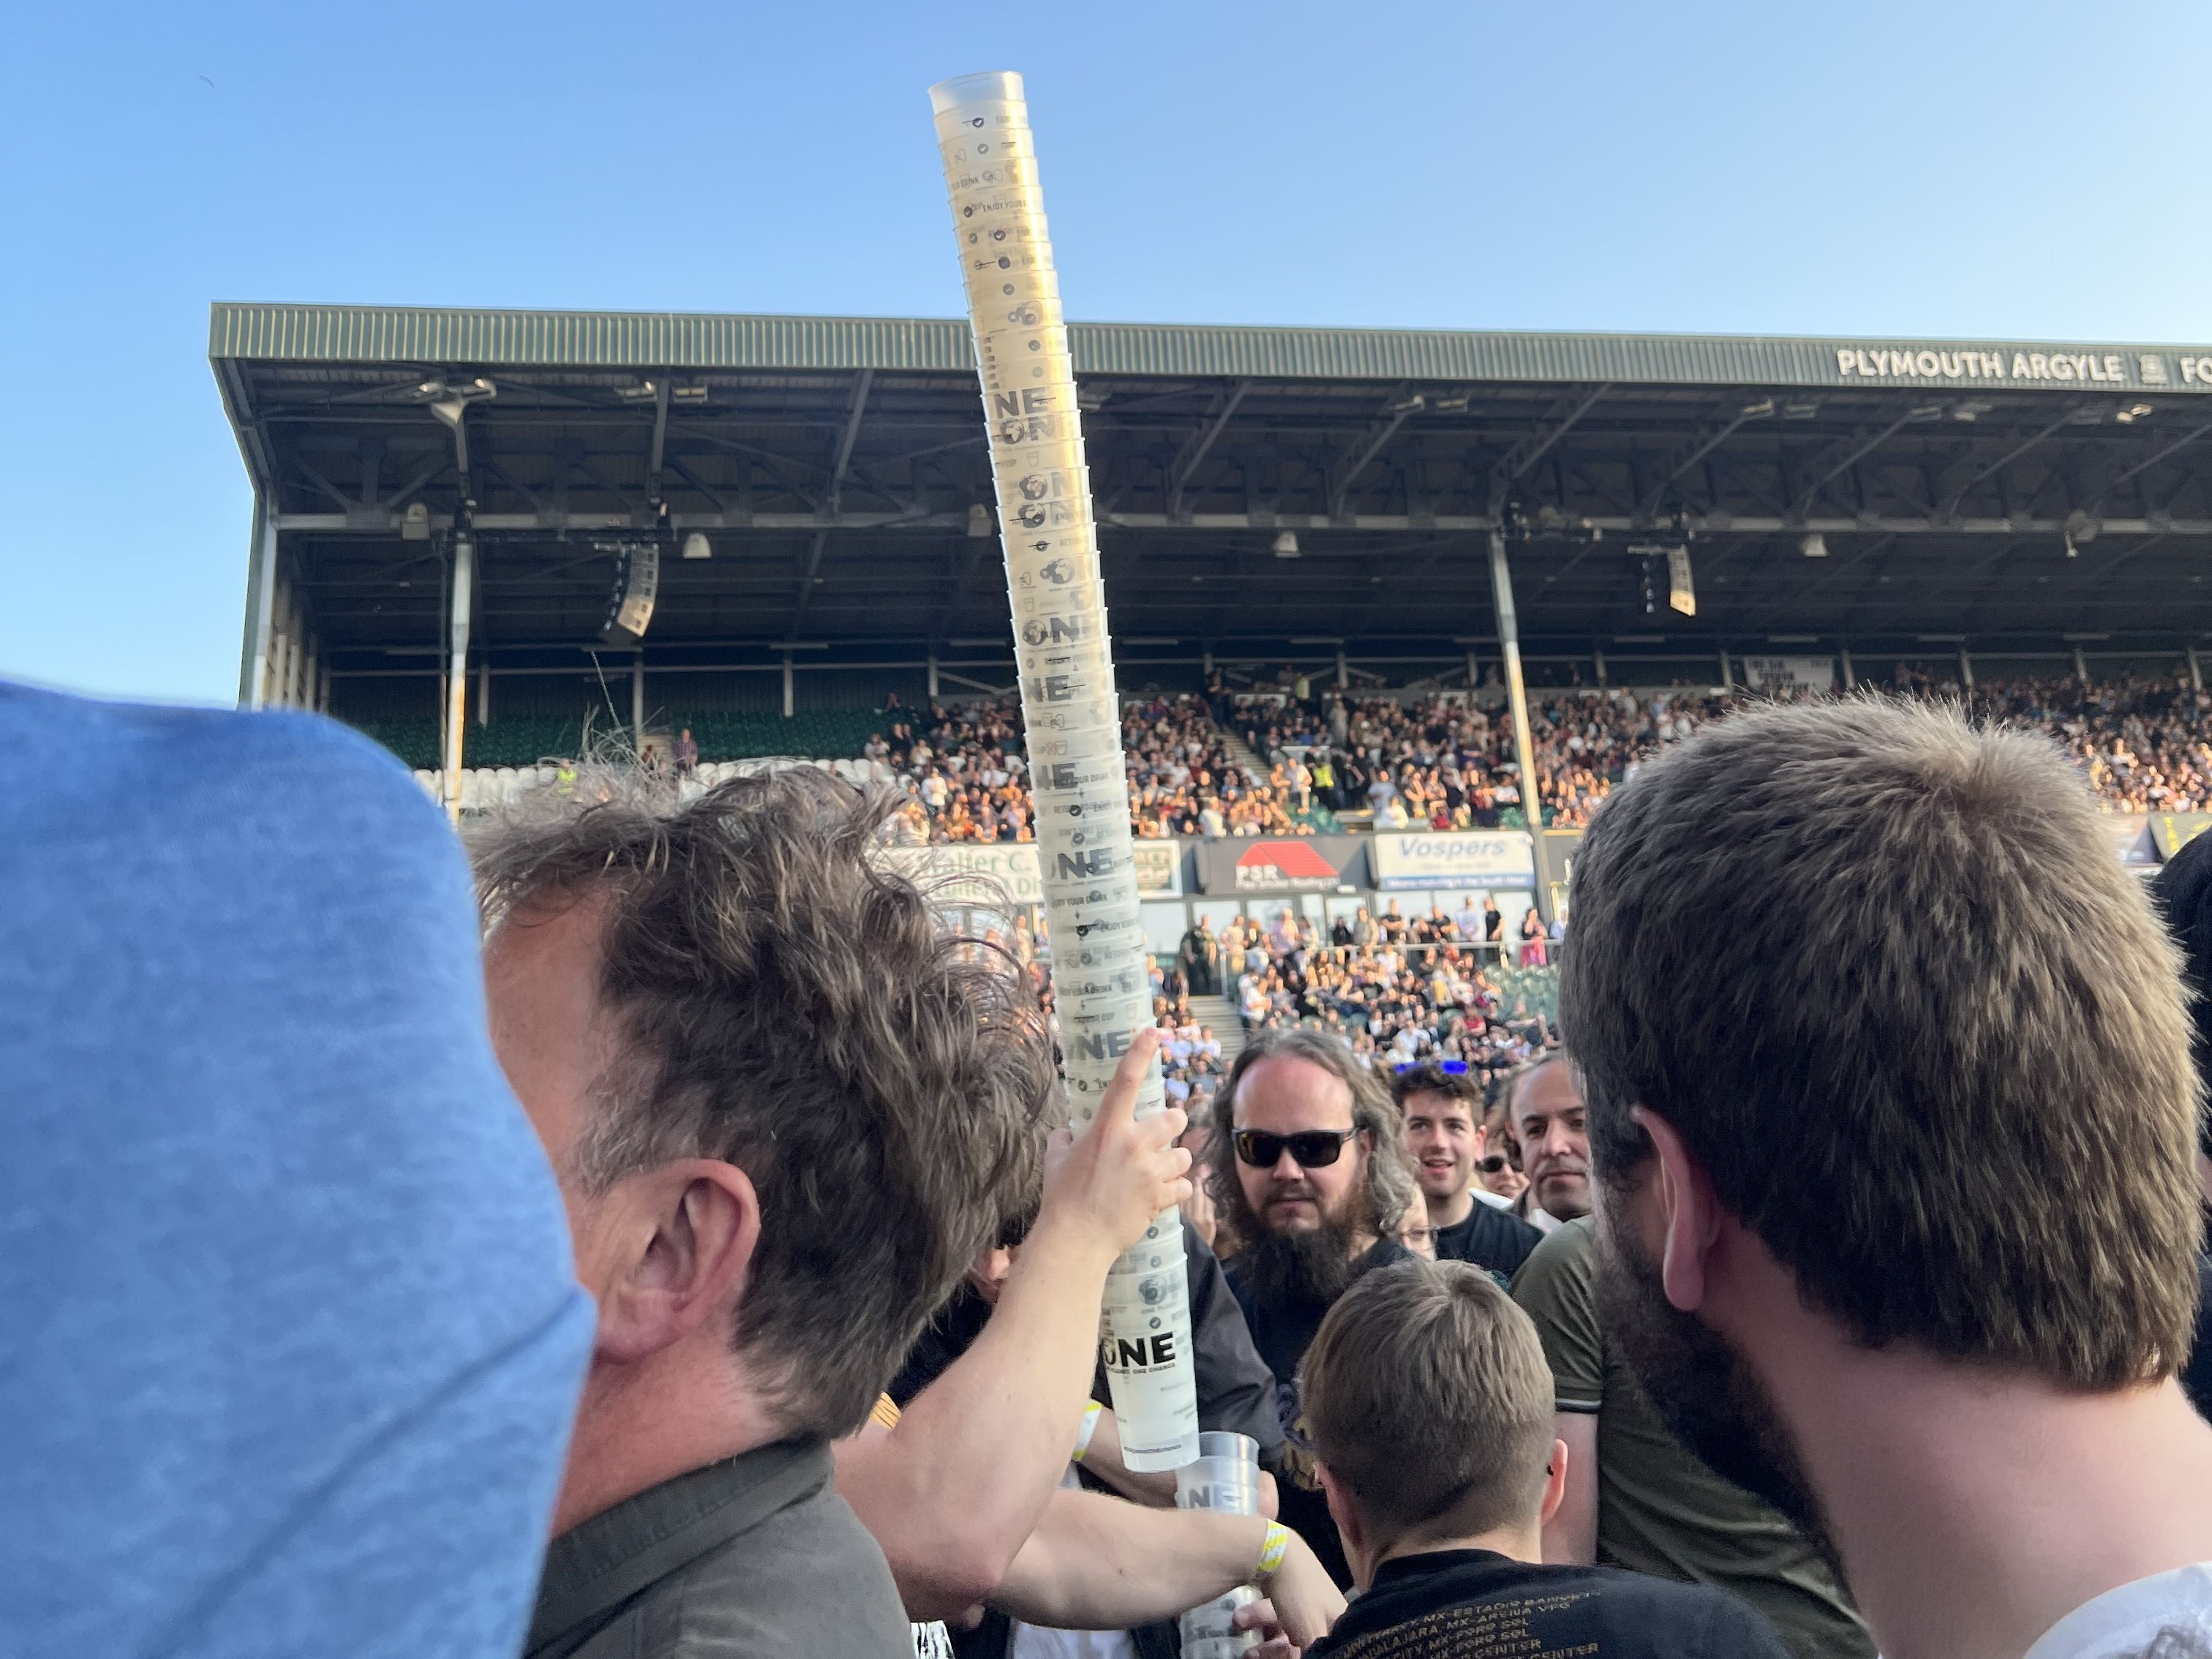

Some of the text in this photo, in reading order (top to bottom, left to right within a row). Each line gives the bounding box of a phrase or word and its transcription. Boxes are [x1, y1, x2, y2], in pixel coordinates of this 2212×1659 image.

[1837, 349, 2004, 378] PLYMOUTH
[2012, 352, 2124, 381] ARGYLE
[1399, 837, 1508, 862] Vospers
[1051, 847, 1114, 880] NE
[1235, 864, 1279, 882] PSR
[1099, 1331, 1176, 1367] ONE
[1478, 1608, 1532, 1624] ARENA
[1501, 1617, 1530, 1629] SOL
[1501, 1628, 1530, 1640] SOL
[1475, 1638, 1542, 1659] CENTER
